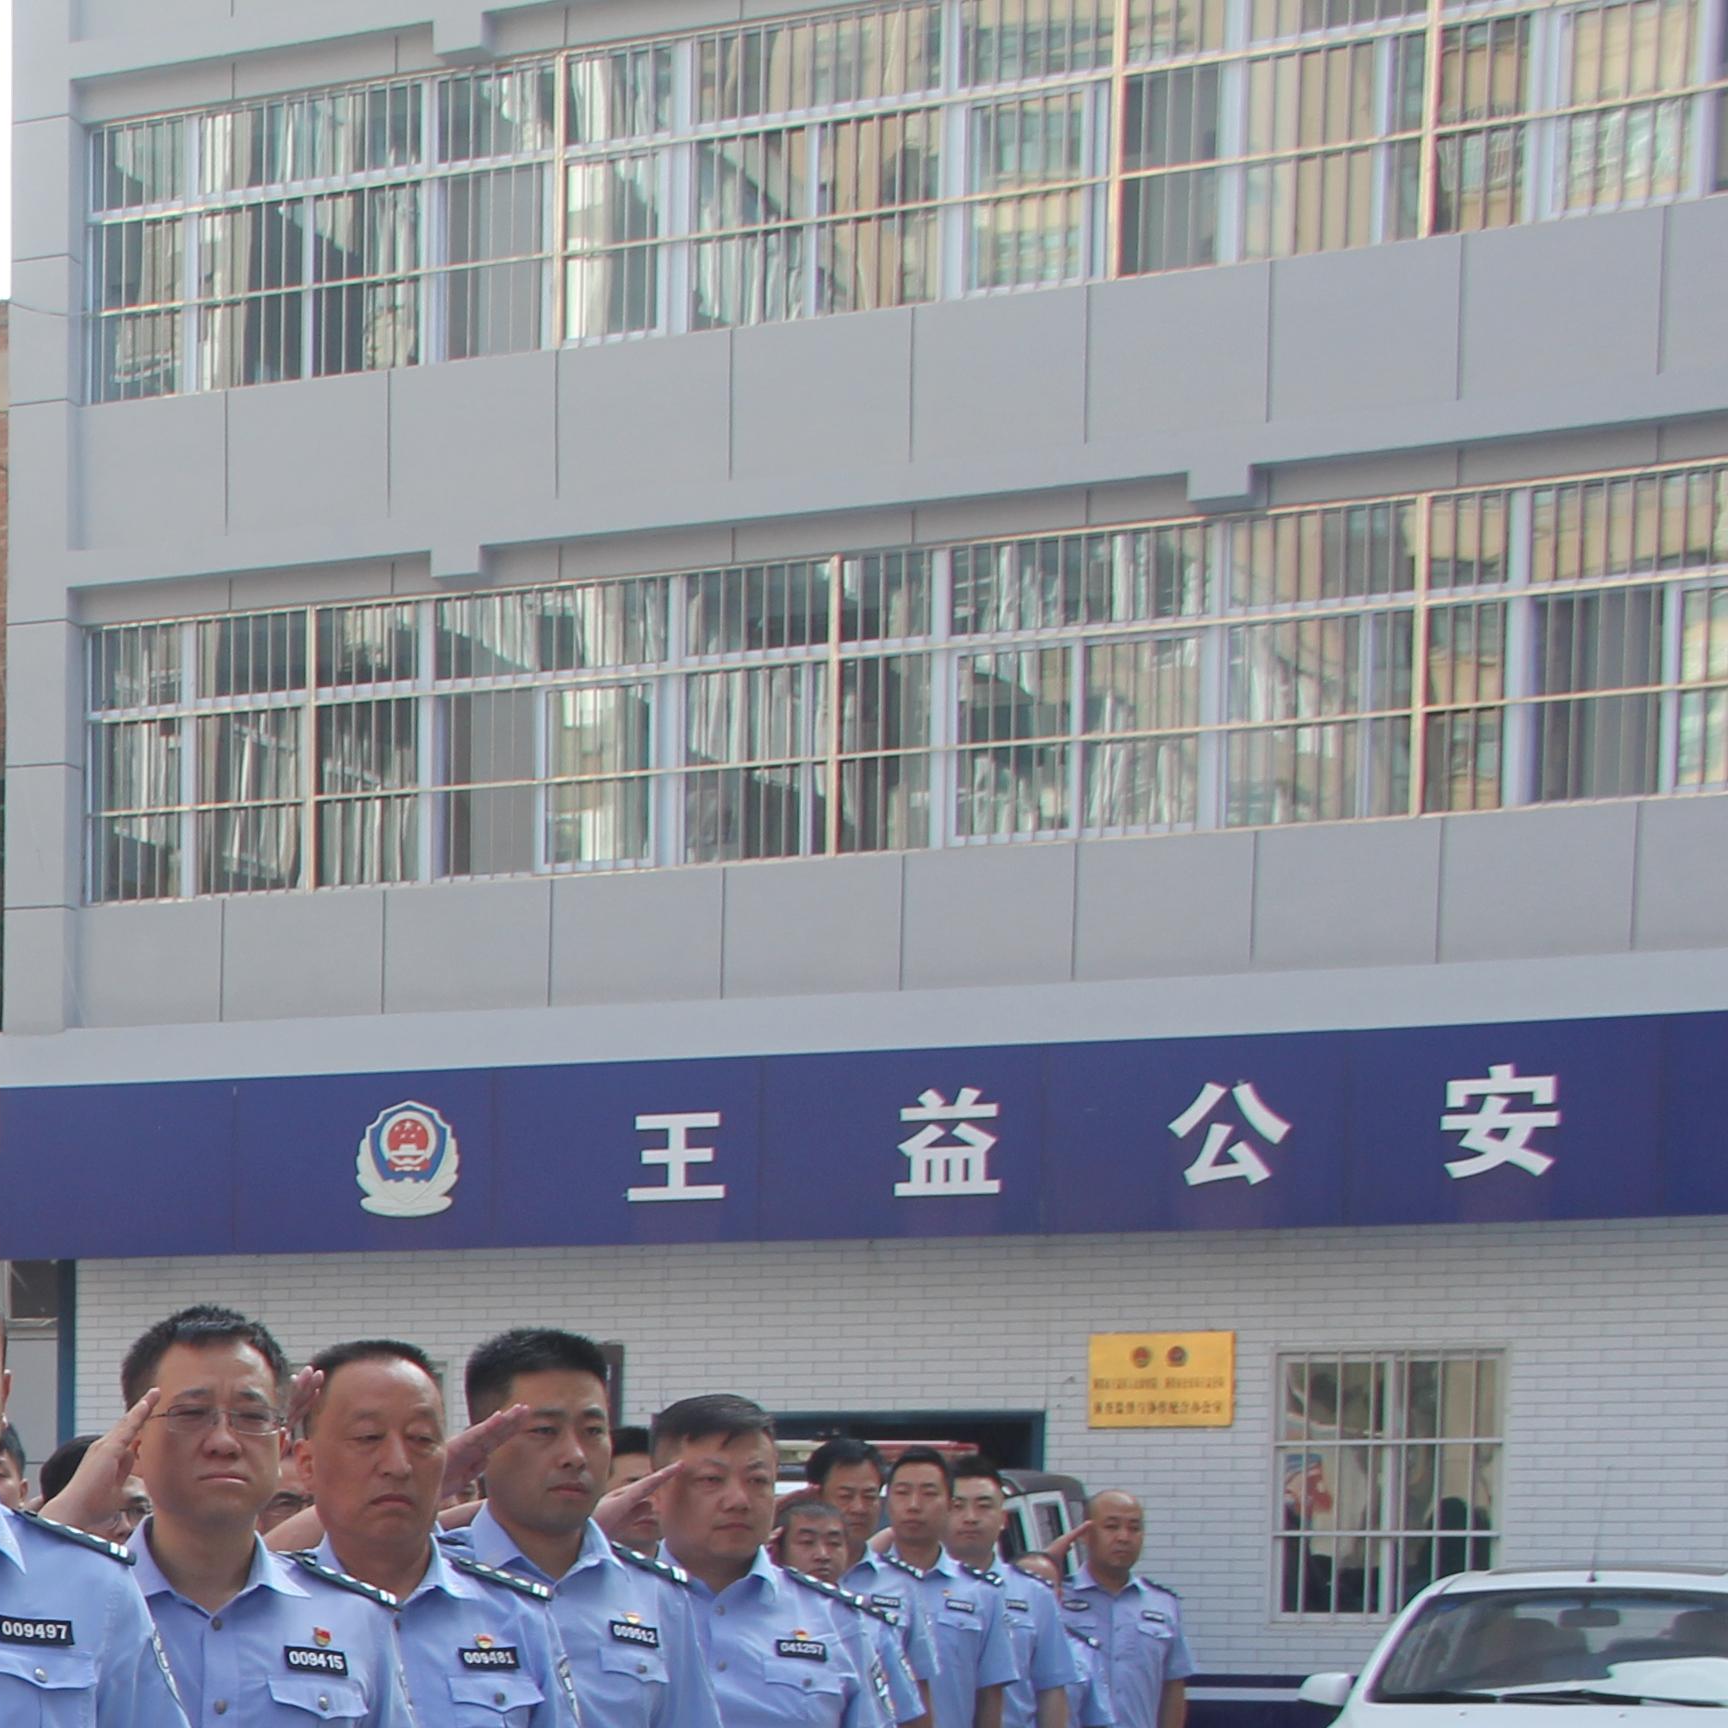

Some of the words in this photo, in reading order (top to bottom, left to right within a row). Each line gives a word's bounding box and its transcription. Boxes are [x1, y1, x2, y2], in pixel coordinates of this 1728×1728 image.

[627, 1064, 1561, 1203] 王益公安
[1, 1620, 69, 1641] 009497
[288, 1650, 344, 1671] 009415
